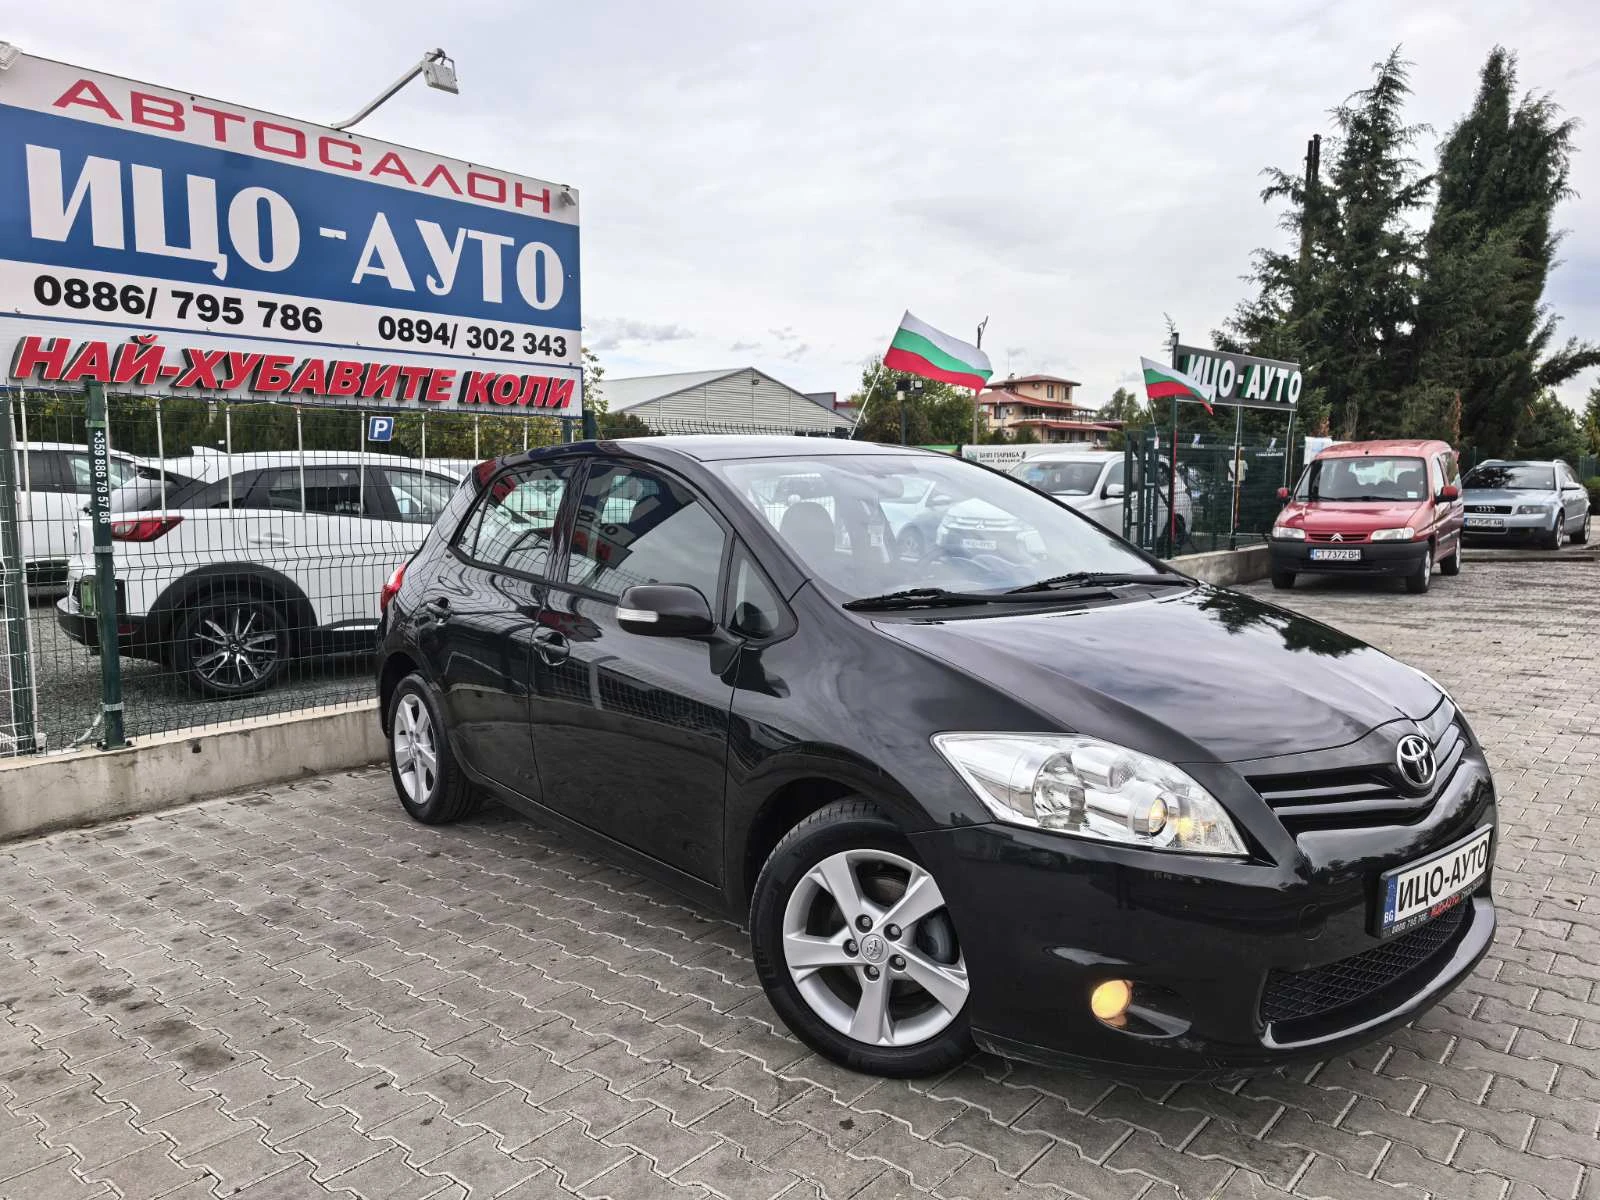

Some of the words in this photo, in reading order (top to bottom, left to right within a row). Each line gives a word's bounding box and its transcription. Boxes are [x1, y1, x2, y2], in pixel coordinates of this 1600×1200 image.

[53, 79, 551, 213] АВТОСАЛОН
[33, 274, 158, 319] 0886/
[171, 290, 243, 325] 795
[257, 301, 323, 333] 786
[378, 316, 458, 349] 0894/
[466, 325, 515, 353] 302
[523, 331, 567, 357] 343
[12, 333, 456, 401] НАЙ-ХУБАВИТЕ
[464, 371, 575, 409] КОЛИ
[374, 419, 388, 438] P
[94, 431, 105, 456] +359
[95, 459, 106, 478] 886
[96, 481, 107, 493] 79
[98, 496, 109, 508] 57
[99, 511, 110, 524] 86
[1397, 840, 1488, 913] ИЦО-АУТО
[1384, 910, 1394, 923] BG
